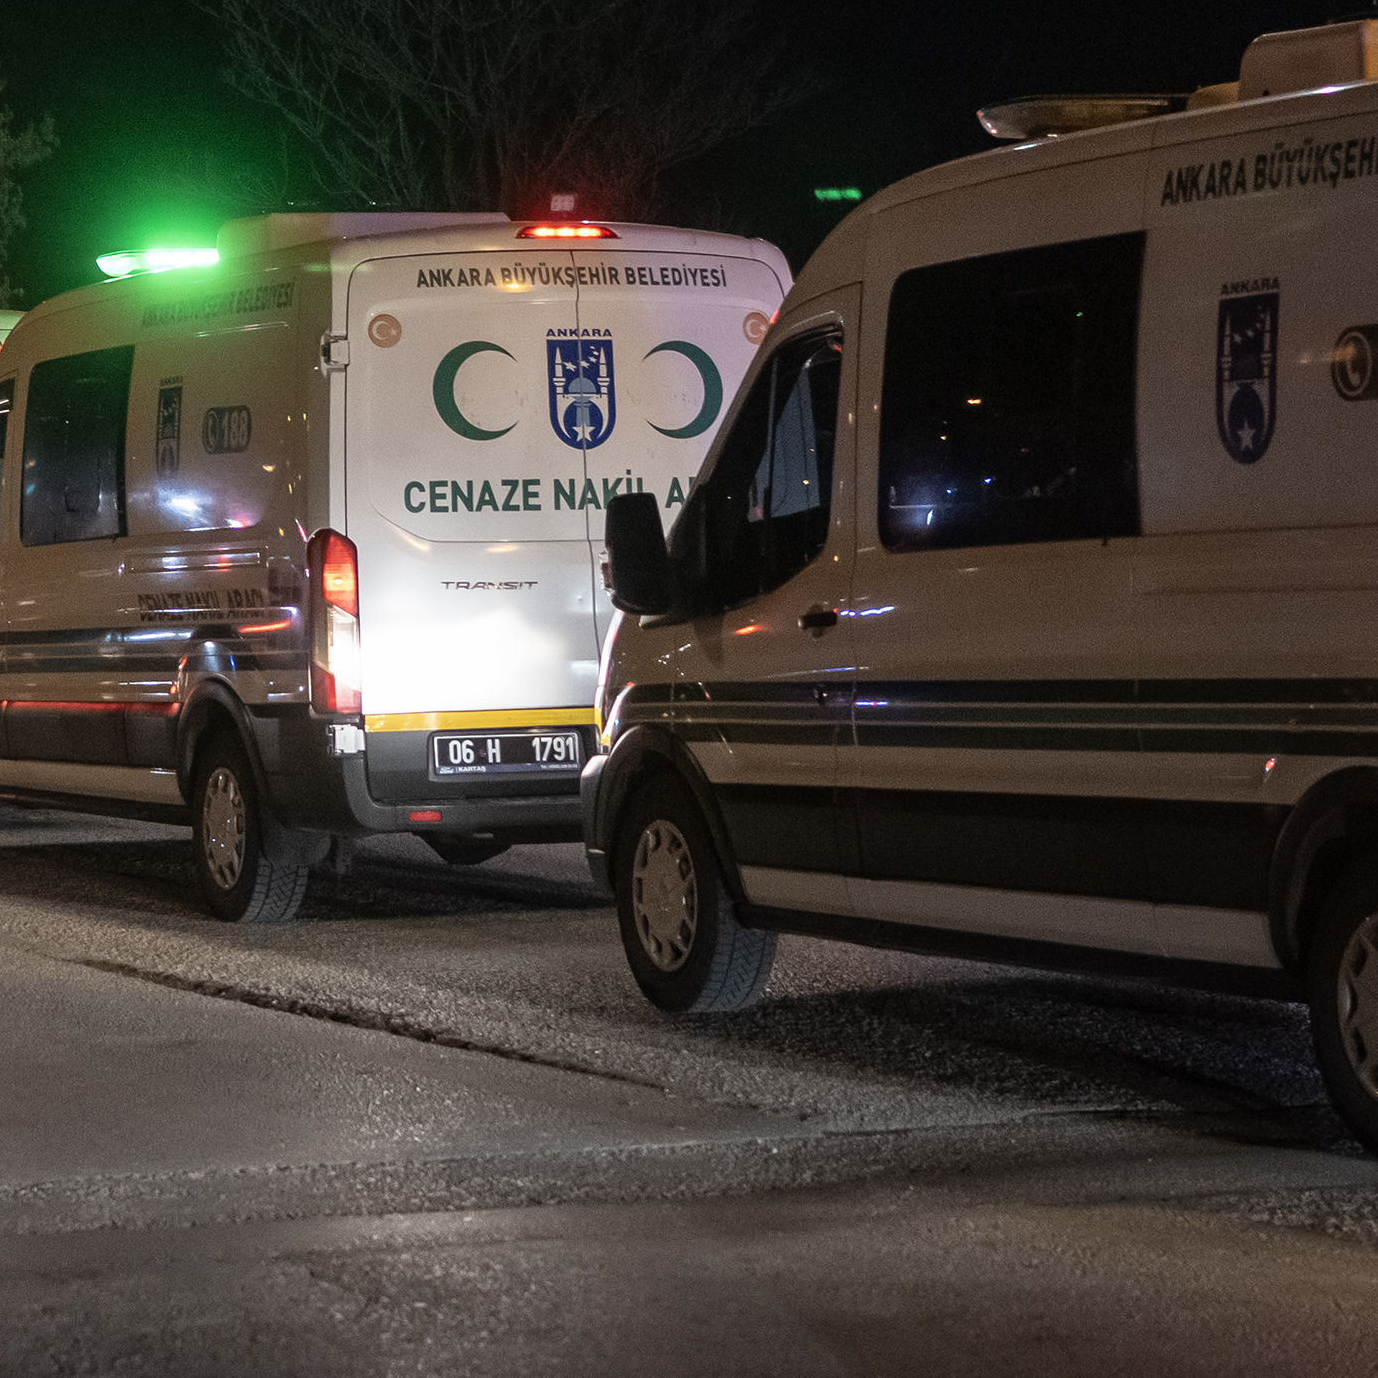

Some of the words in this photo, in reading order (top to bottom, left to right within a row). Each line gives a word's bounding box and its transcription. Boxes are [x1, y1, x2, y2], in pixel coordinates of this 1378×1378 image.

[1161, 158, 1247, 207] ANKARA
[417, 268, 497, 288] ANKARA
[501, 262, 620, 289] BÜYÜKŞEHİR
[625, 263, 728, 287] BELEDİYESİ
[1222, 277, 1280, 295] ANKARA
[546, 328, 613, 338] ANKARA
[404, 478, 542, 513] CENAZE
[441, 581, 538, 590] TRANSIT
[448, 739, 475, 764] 06
[486, 738, 501, 763] H
[532, 736, 575, 762] 1791
